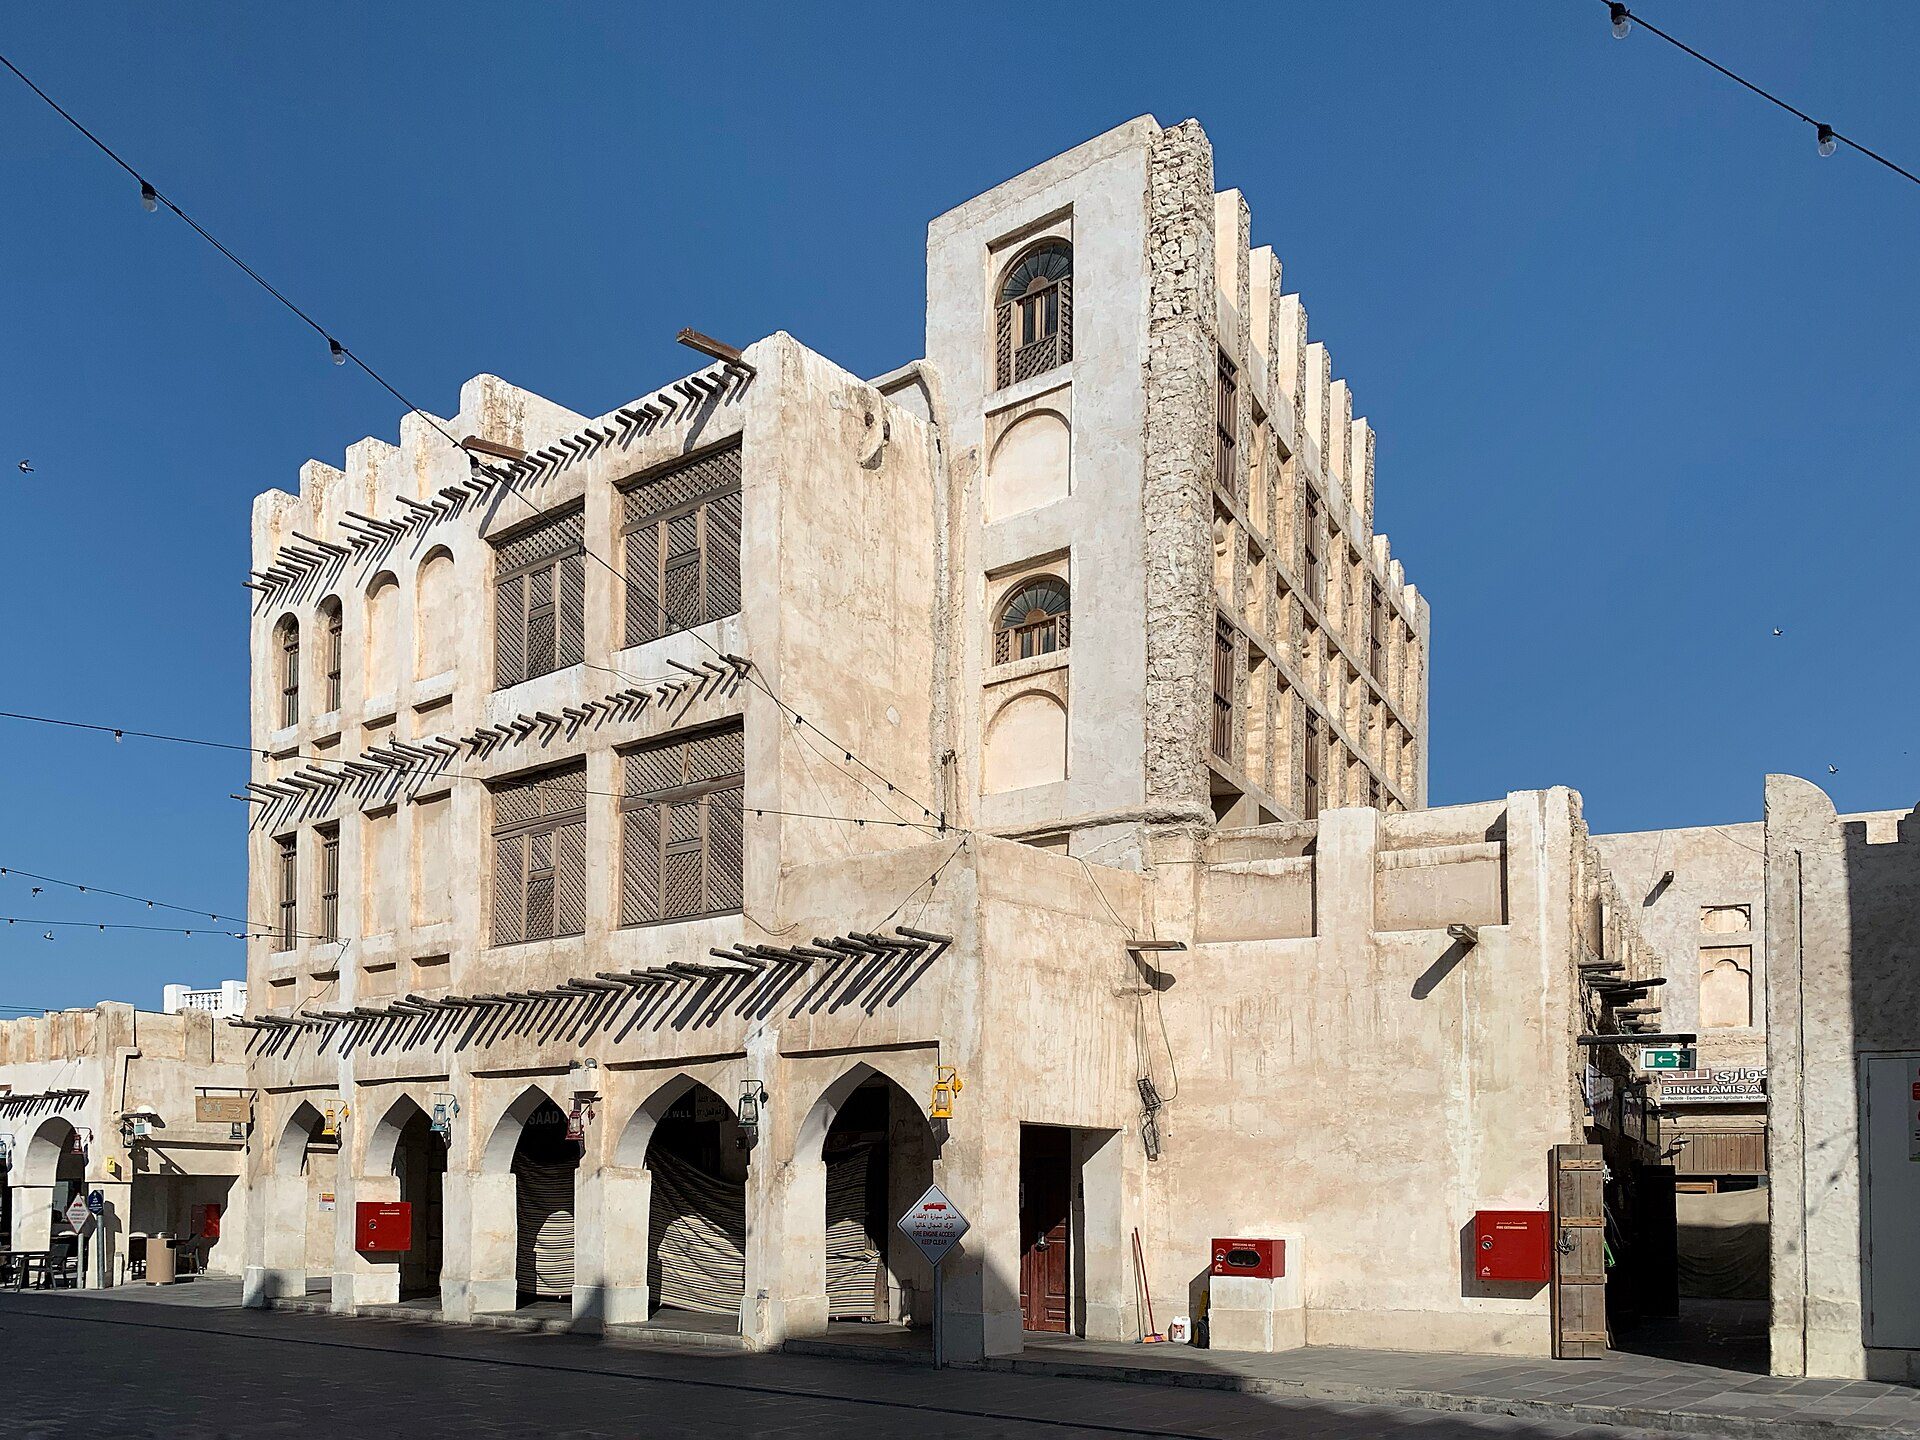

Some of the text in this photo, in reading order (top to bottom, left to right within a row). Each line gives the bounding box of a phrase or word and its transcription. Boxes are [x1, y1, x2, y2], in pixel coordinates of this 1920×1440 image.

[1663, 1086, 1686, 1094] BIN
[1690, 1085, 1746, 1094] KHAMIS
[528, 1110, 560, 1126] SAAD
